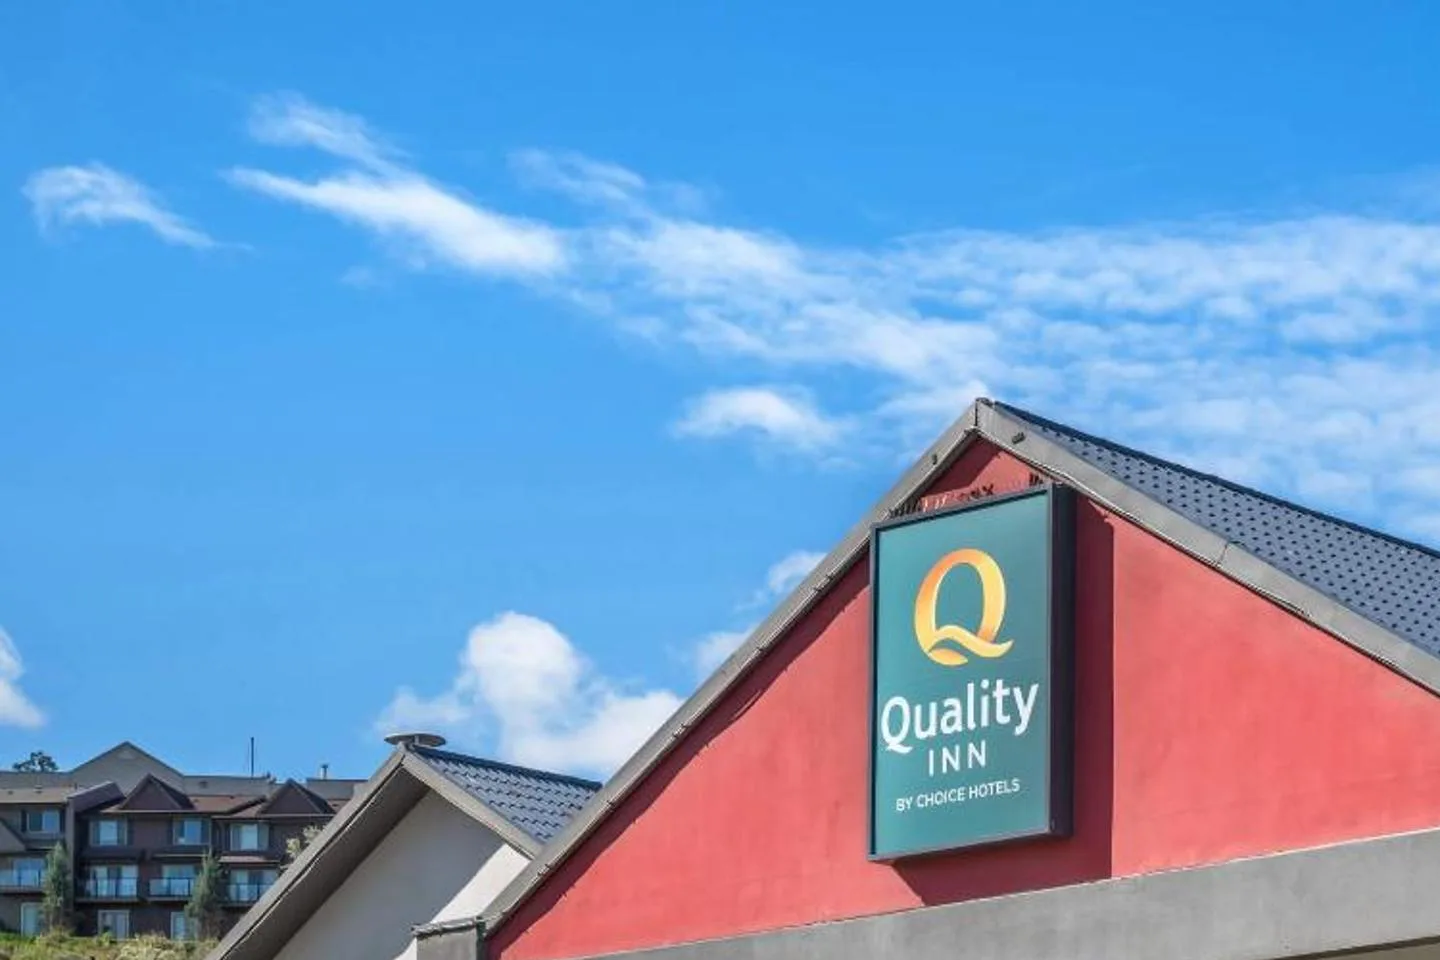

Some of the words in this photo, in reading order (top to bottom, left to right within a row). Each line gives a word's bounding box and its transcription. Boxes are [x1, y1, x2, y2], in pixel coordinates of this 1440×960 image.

[915, 548, 1014, 665] Q
[881, 678, 1039, 754] Quality
[928, 740, 986, 777] INN
[895, 797, 913, 811] BY
[916, 787, 966, 808] CHOICE
[968, 778, 1021, 799] HOTELS
